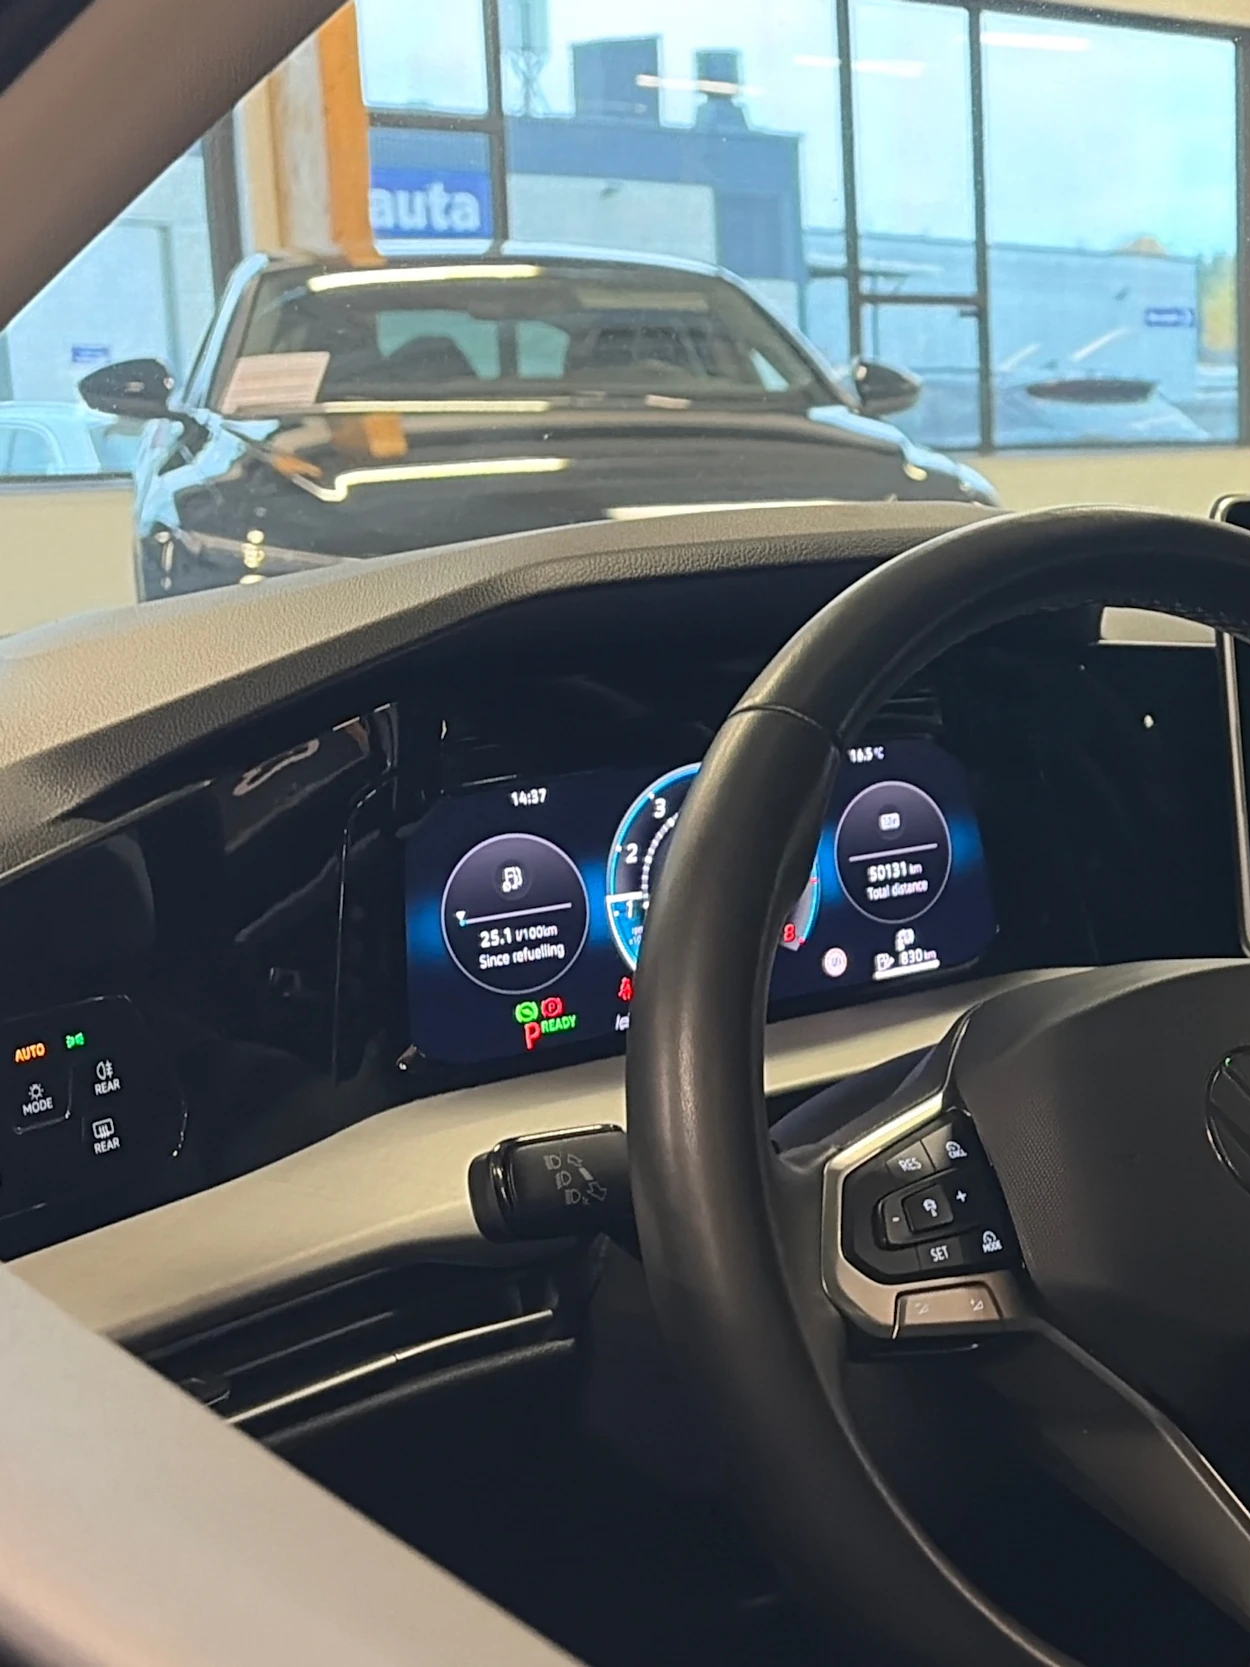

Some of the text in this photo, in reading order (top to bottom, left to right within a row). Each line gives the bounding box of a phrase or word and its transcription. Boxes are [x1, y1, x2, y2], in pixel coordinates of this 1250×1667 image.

[511, 788, 547, 806] 14:37
[653, 798, 666, 818] 3
[626, 843, 638, 864] 2
[867, 860, 907, 883] 50131
[866, 879, 928, 900] Total distance
[626, 901, 633, 919] 1
[479, 927, 512, 948] 25.1
[784, 923, 796, 942] 8
[479, 943, 565, 969] Since refuelling
[899, 948, 923, 965] 830
[524, 1014, 576, 1050] P READY
[15, 1043, 46, 1063] AUTO
[94, 1078, 121, 1095] REAR
[22, 1097, 53, 1116] MODE
[94, 1137, 120, 1155] REAR
[898, 1158, 922, 1172] RES
[930, 1245, 949, 1262] SET
